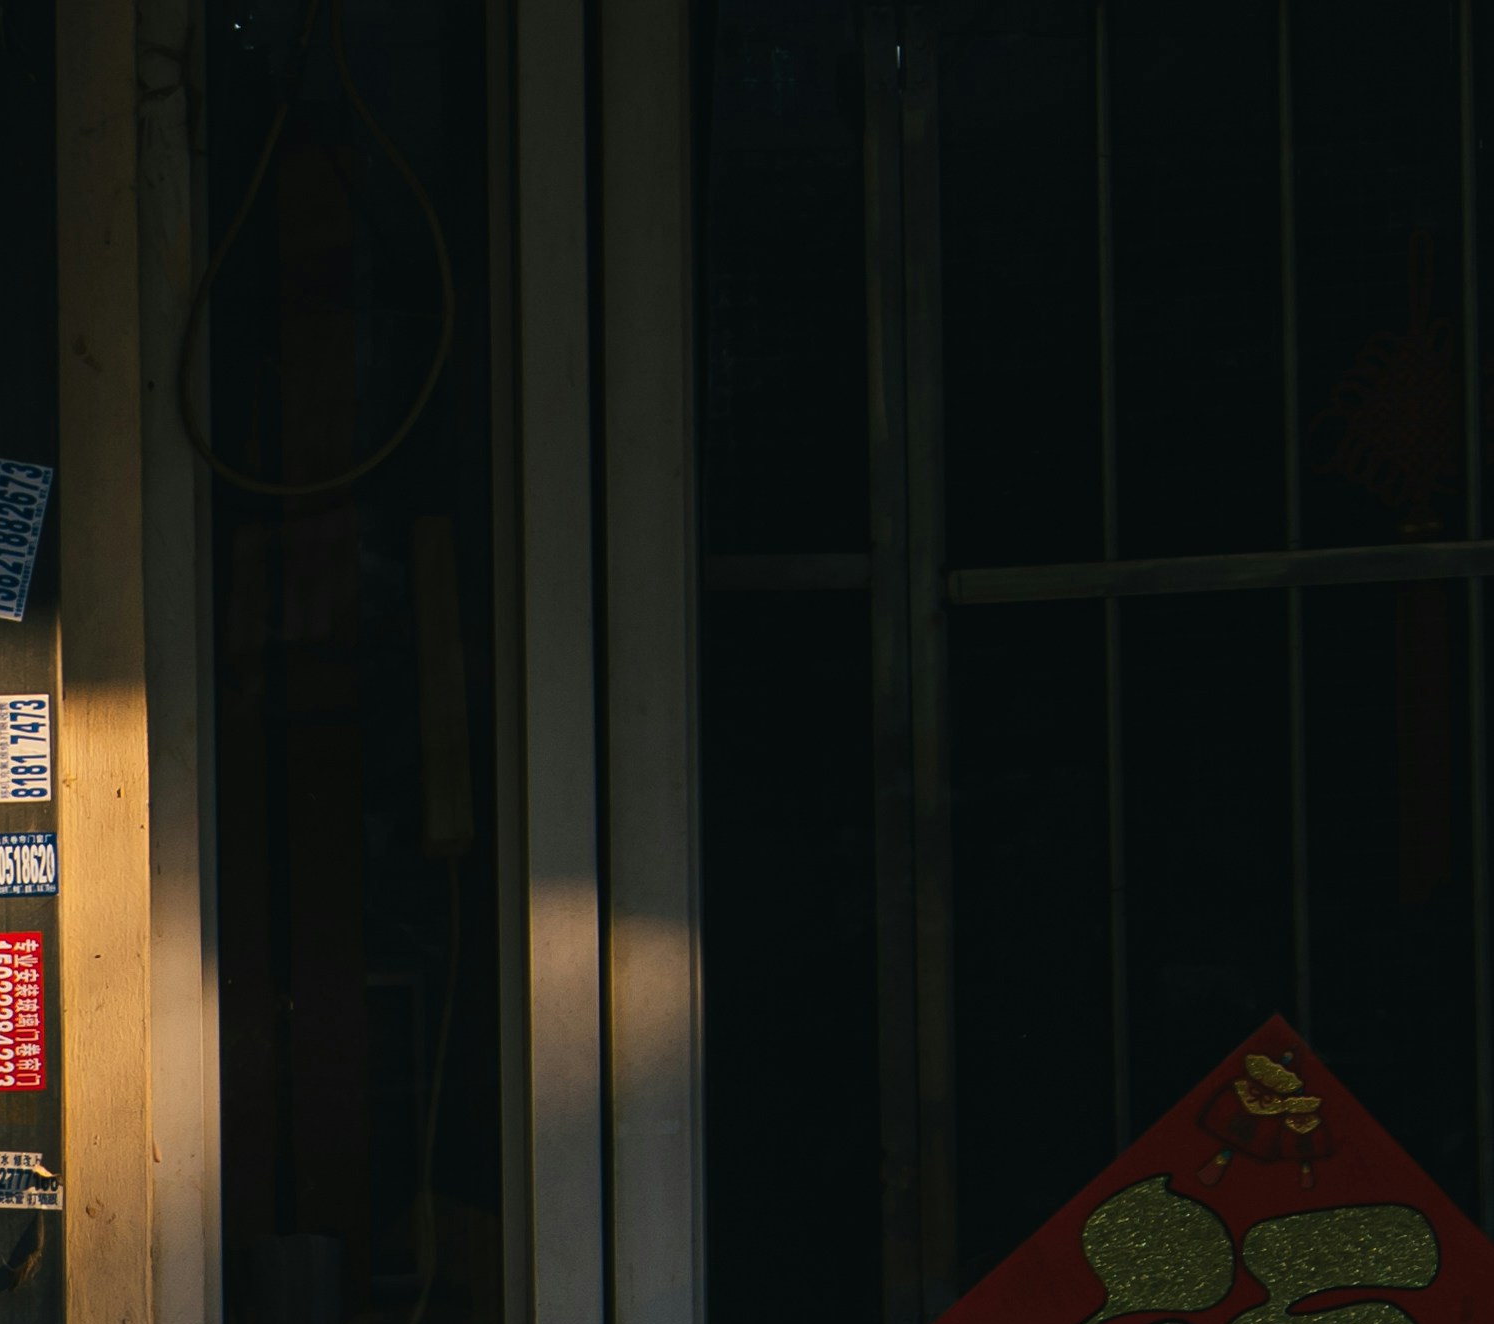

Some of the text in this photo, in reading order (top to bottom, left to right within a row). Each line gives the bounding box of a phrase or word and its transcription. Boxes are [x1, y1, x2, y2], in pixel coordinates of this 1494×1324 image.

[9, 698, 48, 800] 8181 7473
[14, 938, 41, 1087] 专业安装玻璃门卷帘门
